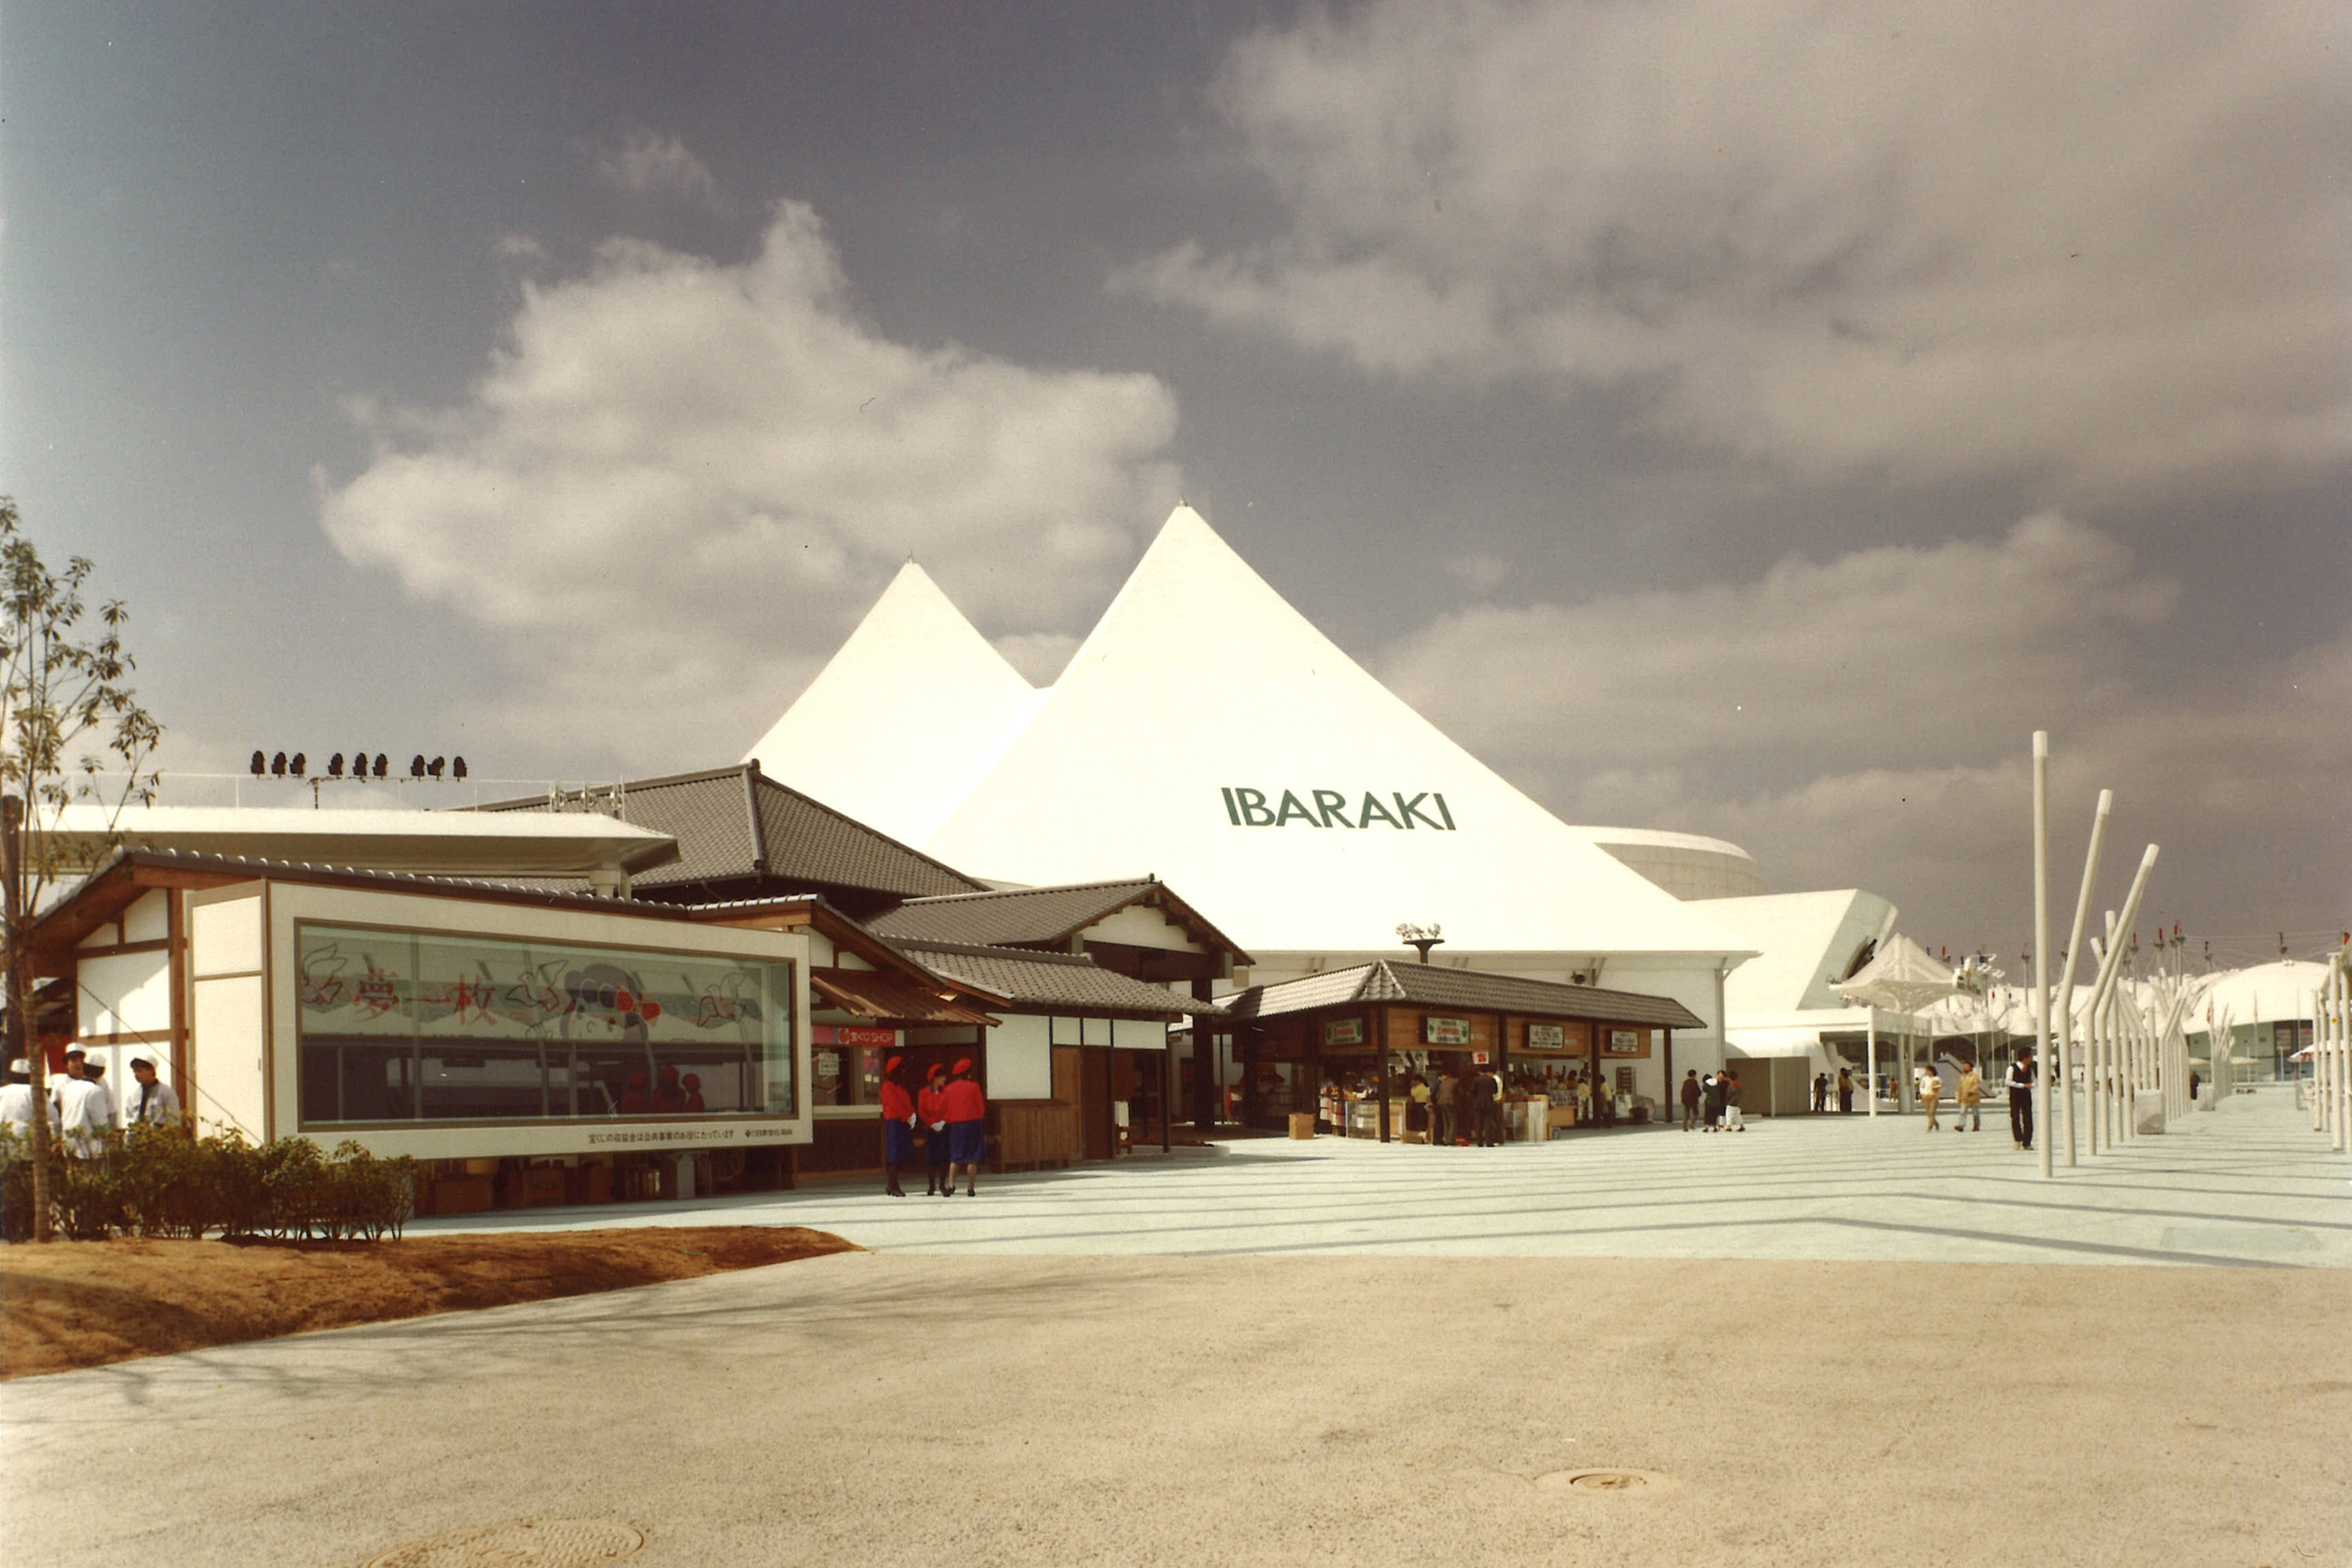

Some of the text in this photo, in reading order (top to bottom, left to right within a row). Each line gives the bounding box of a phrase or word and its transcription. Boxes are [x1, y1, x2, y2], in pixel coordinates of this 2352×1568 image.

[1221, 787, 1457, 830] IBARAKI
[353, 967, 498, 1025] 夢一枚
